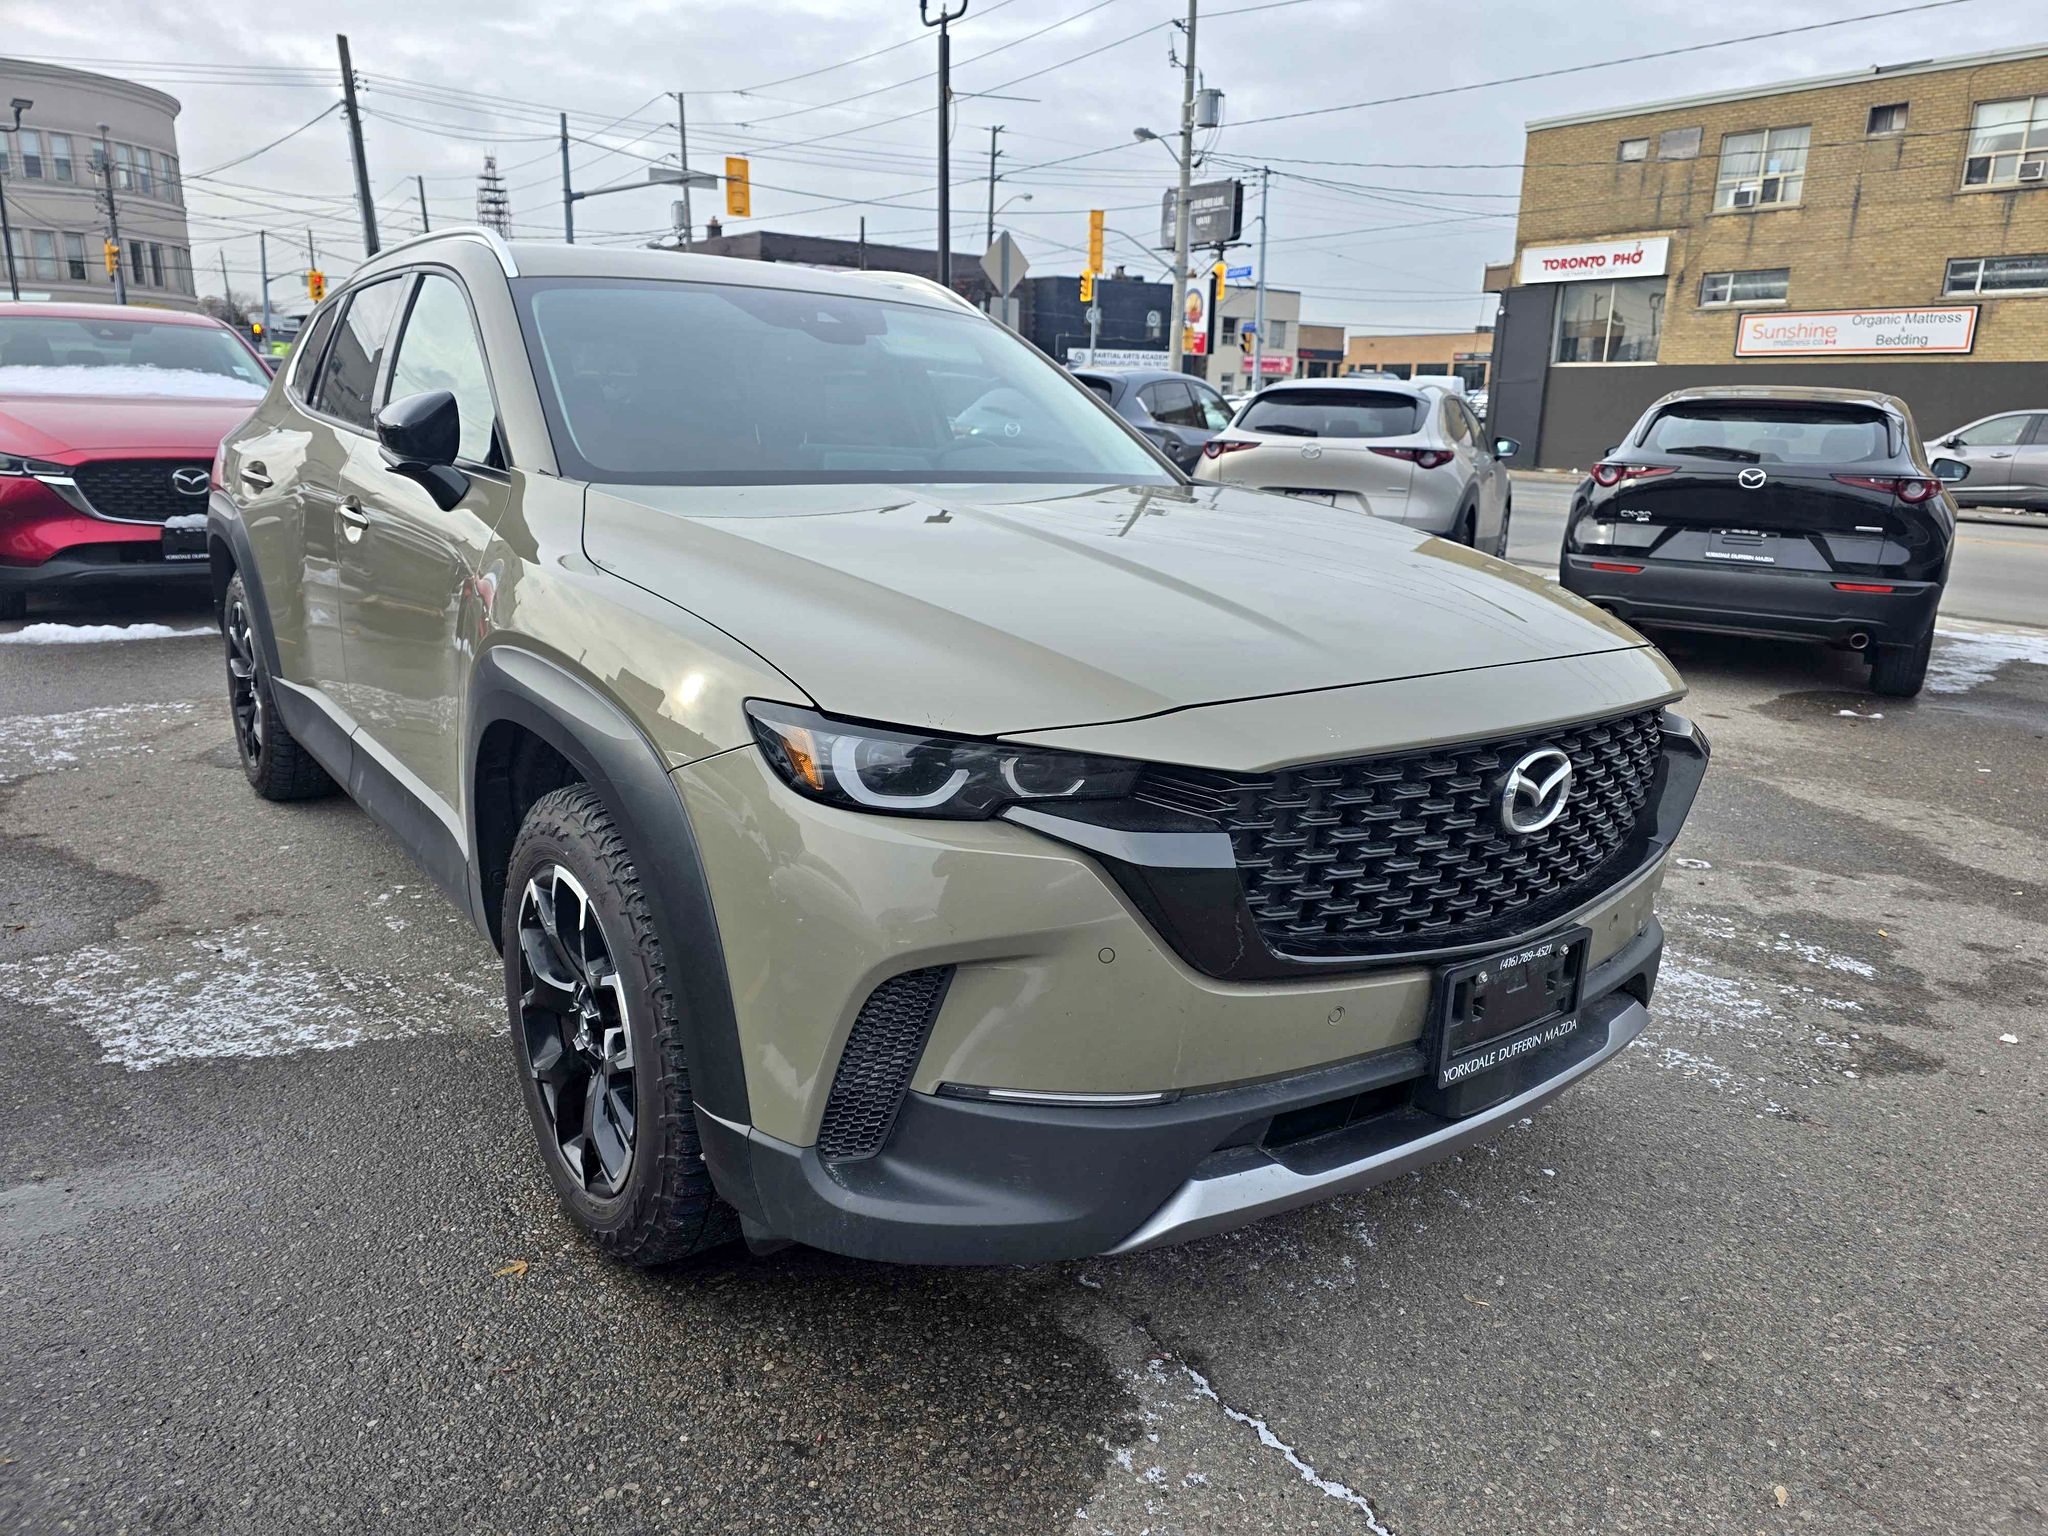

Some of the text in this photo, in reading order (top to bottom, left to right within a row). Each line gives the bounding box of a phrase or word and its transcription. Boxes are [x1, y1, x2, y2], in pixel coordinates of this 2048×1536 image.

[1542, 255, 1606, 271] TORONTO
[1852, 313, 1962, 328] Organic Mattress
[1752, 323, 1837, 340] Sunshine
[1876, 334, 1928, 347] Bedding
[1121, 352, 1139, 360] ARTS
[1500, 944, 1552, 970] (416) 789-4521
[1443, 1019, 1577, 1082] YORKDALE DUFFERIN MAZDA
